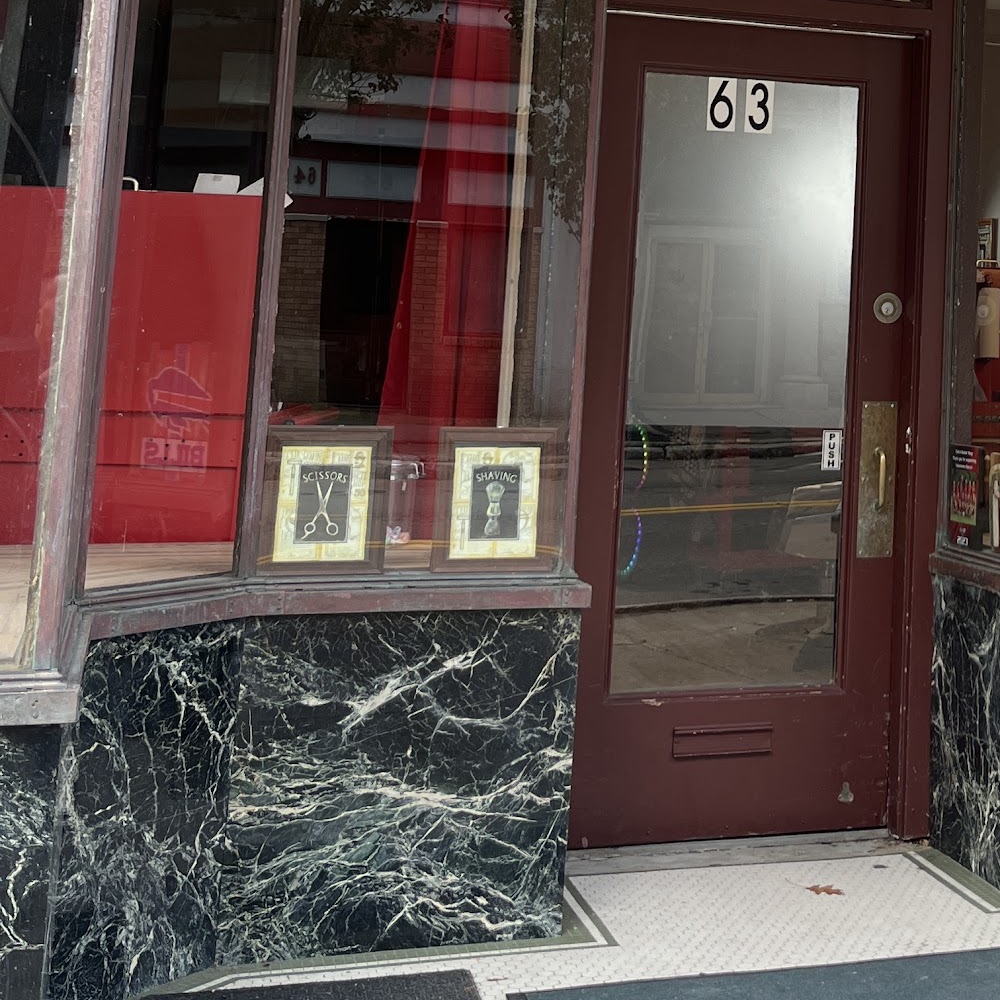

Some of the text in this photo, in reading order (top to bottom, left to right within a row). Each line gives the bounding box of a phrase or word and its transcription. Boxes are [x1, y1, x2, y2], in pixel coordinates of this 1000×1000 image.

[710, 81, 769, 130] 63
[828, 433, 836, 467] PUSH
[302, 470, 348, 483] SCISSORS
[475, 471, 518, 483] SHAVING
